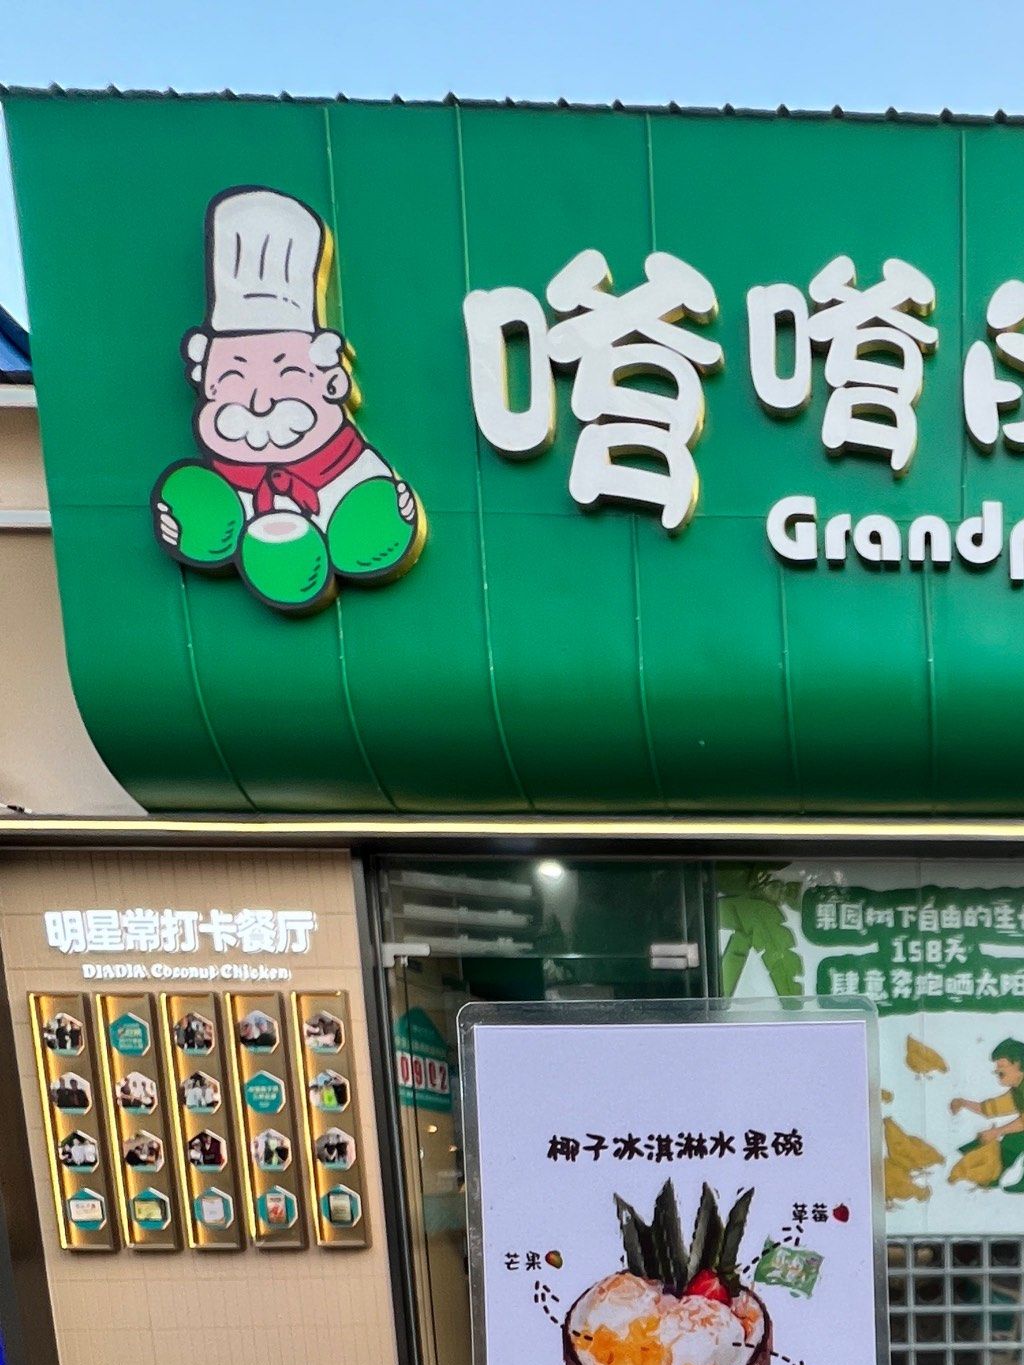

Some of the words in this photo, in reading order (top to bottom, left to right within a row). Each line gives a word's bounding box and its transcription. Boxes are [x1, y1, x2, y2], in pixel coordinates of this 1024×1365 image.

[44, 907, 317, 954] 明星常打卡餐厅
[891, 935, 967, 964] 158天
[82, 963, 148, 980] DIADIA
[546, 1127, 804, 1163] 椰子冰淇淋水果碗
[791, 1202, 829, 1224] 草莓
[504, 1250, 542, 1271] 芒果
